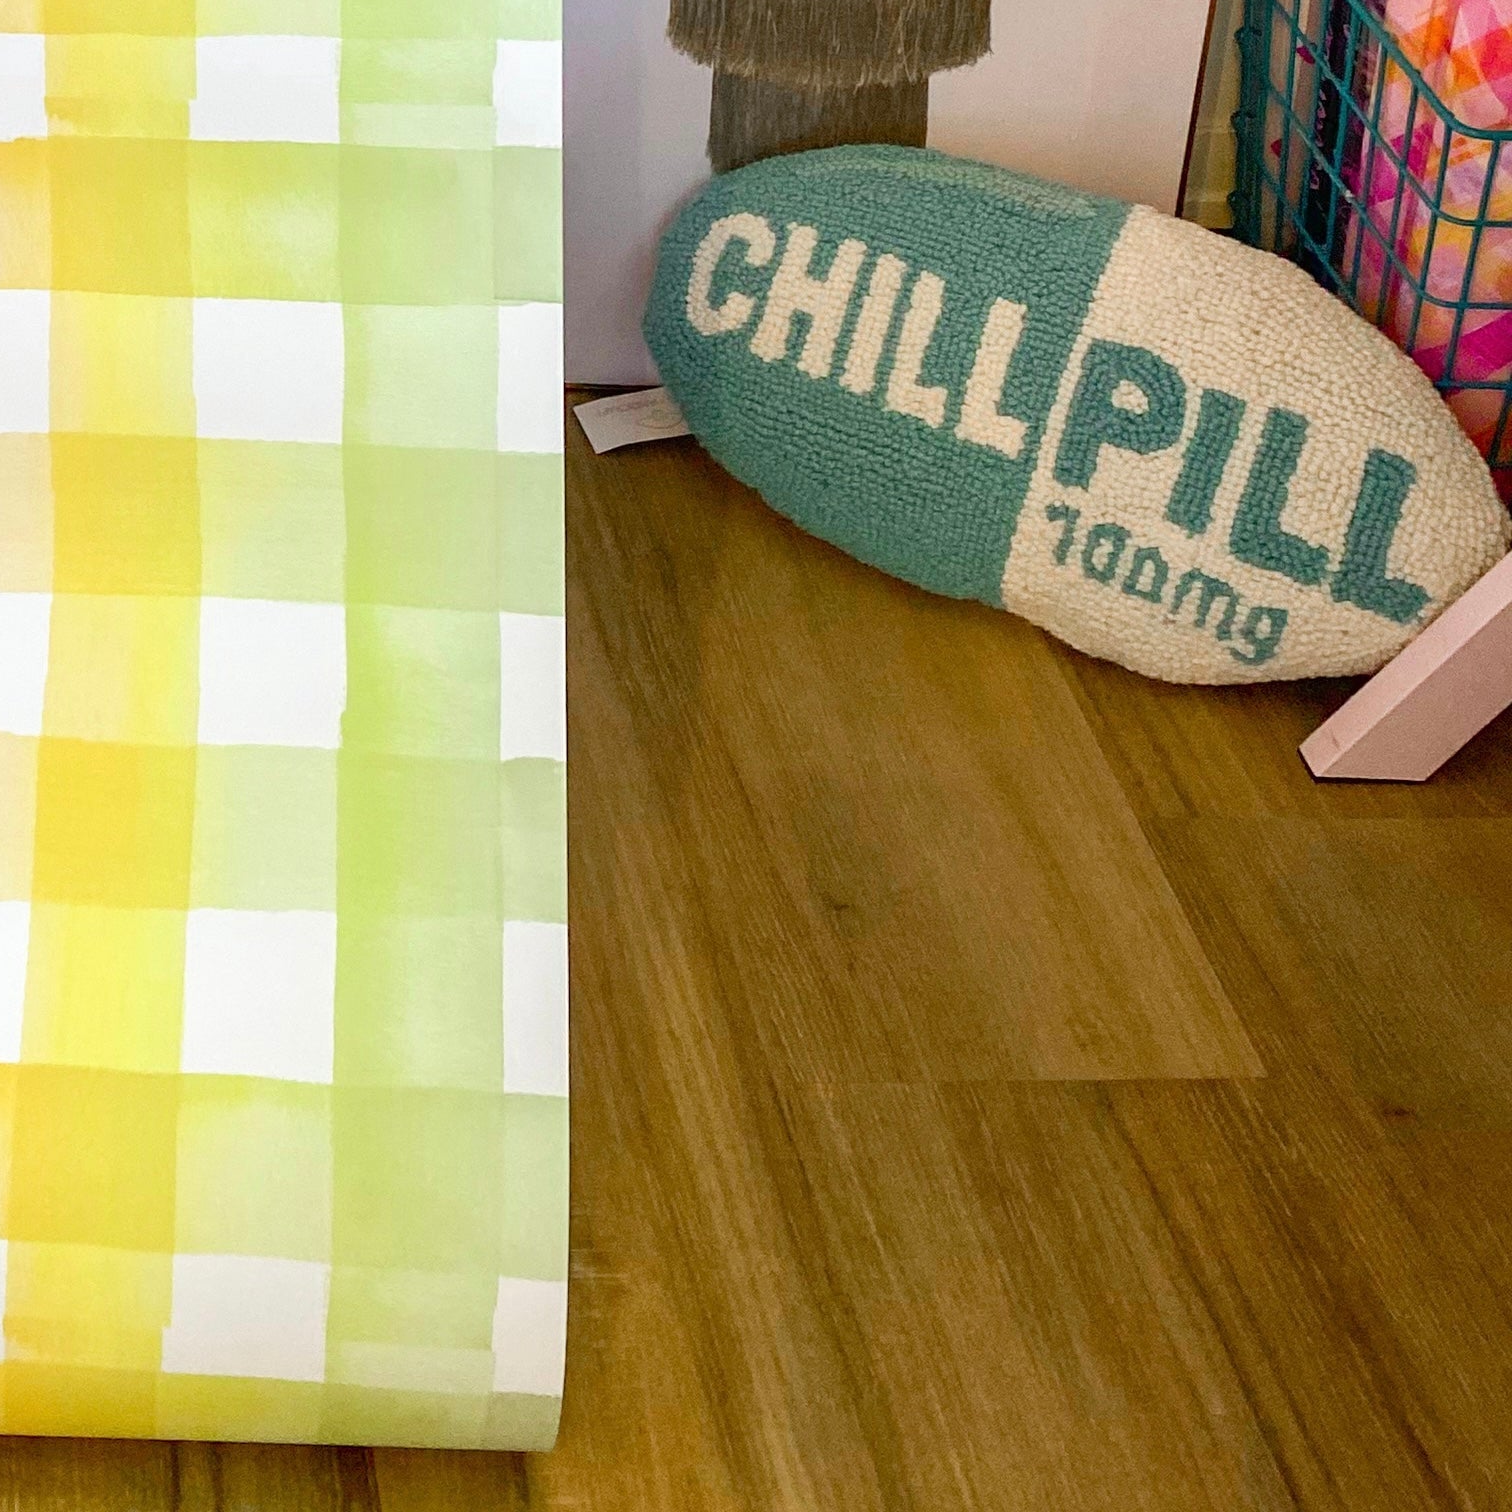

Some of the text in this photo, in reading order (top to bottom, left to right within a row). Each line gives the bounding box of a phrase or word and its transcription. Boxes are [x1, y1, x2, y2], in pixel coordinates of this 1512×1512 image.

[685, 210, 1432, 625] CHILL PILL
[1043, 501, 1290, 667] 100mg
